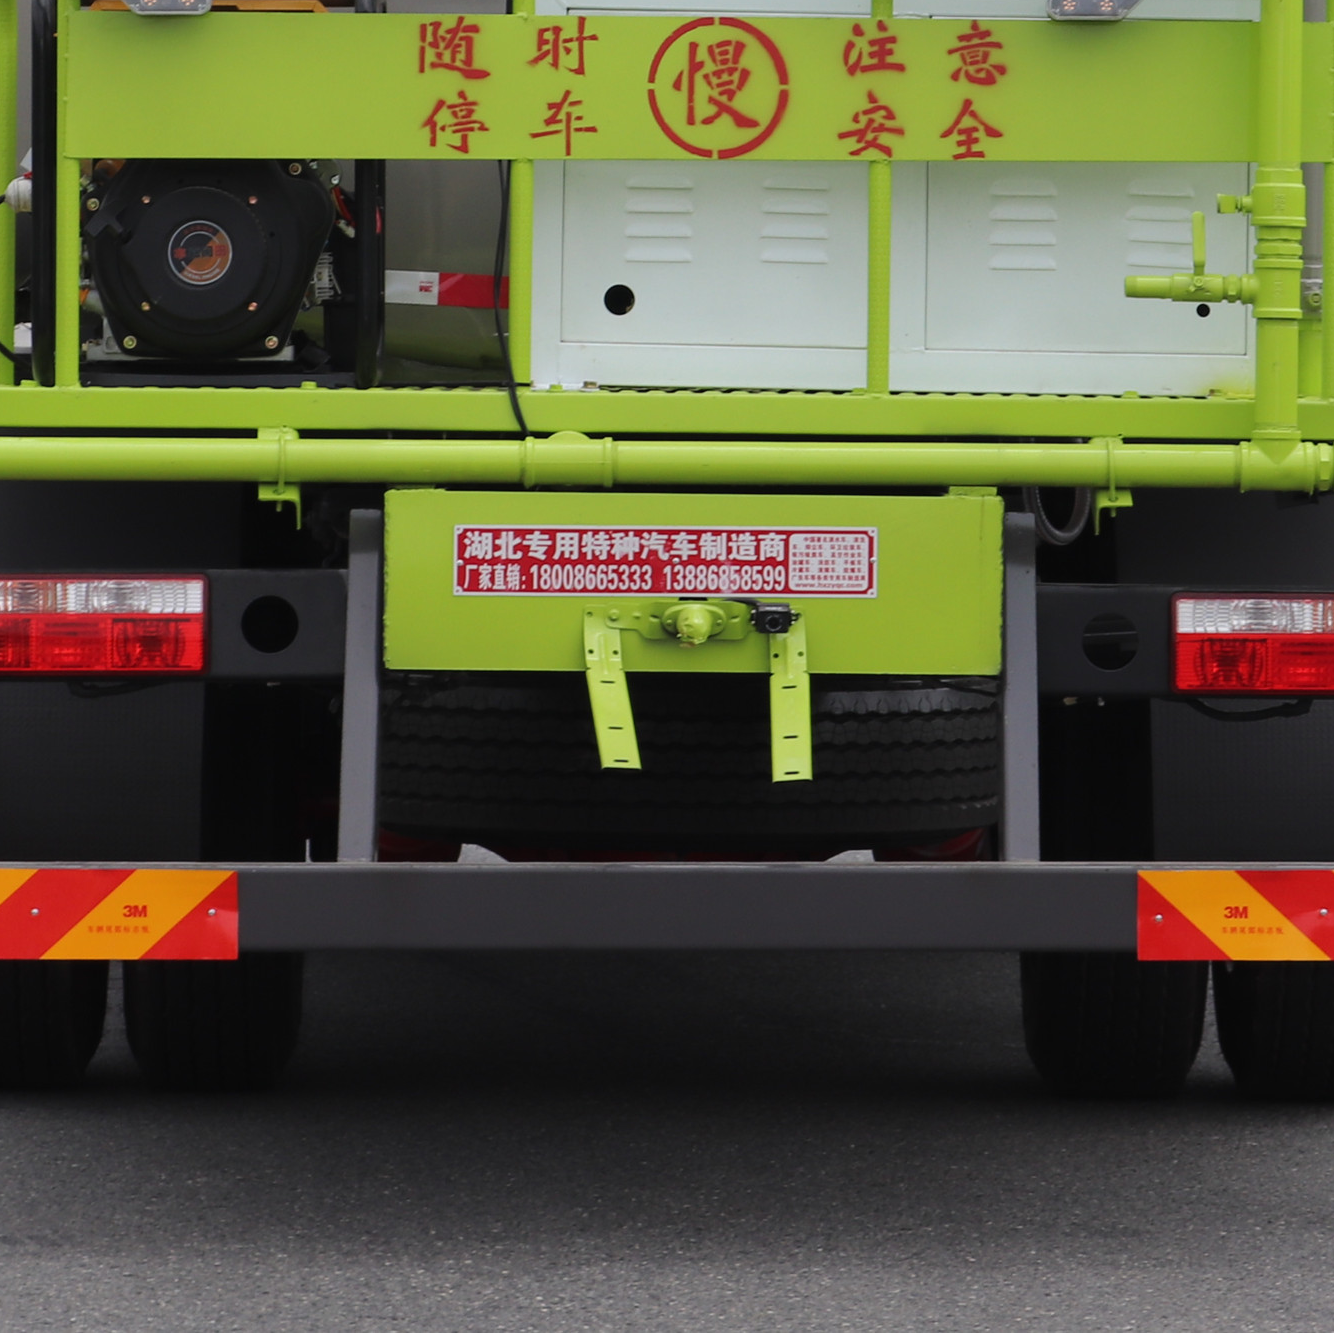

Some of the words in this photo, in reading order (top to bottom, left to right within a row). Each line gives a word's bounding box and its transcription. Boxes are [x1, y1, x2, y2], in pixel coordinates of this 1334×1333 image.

[419, 15, 599, 81] 随时
[842, 20, 1008, 86] 注意
[673, 39, 761, 129] 慢
[421, 89, 599, 157] 停车
[838, 90, 1004, 160] 安全
[464, 531, 787, 562] 湖北专用特种汽车制造商
[530, 564, 653, 590] 18008665333
[663, 565, 786, 591] 13886858599
[122, 905, 148, 918] 3M
[1223, 906, 1249, 919] 3M
